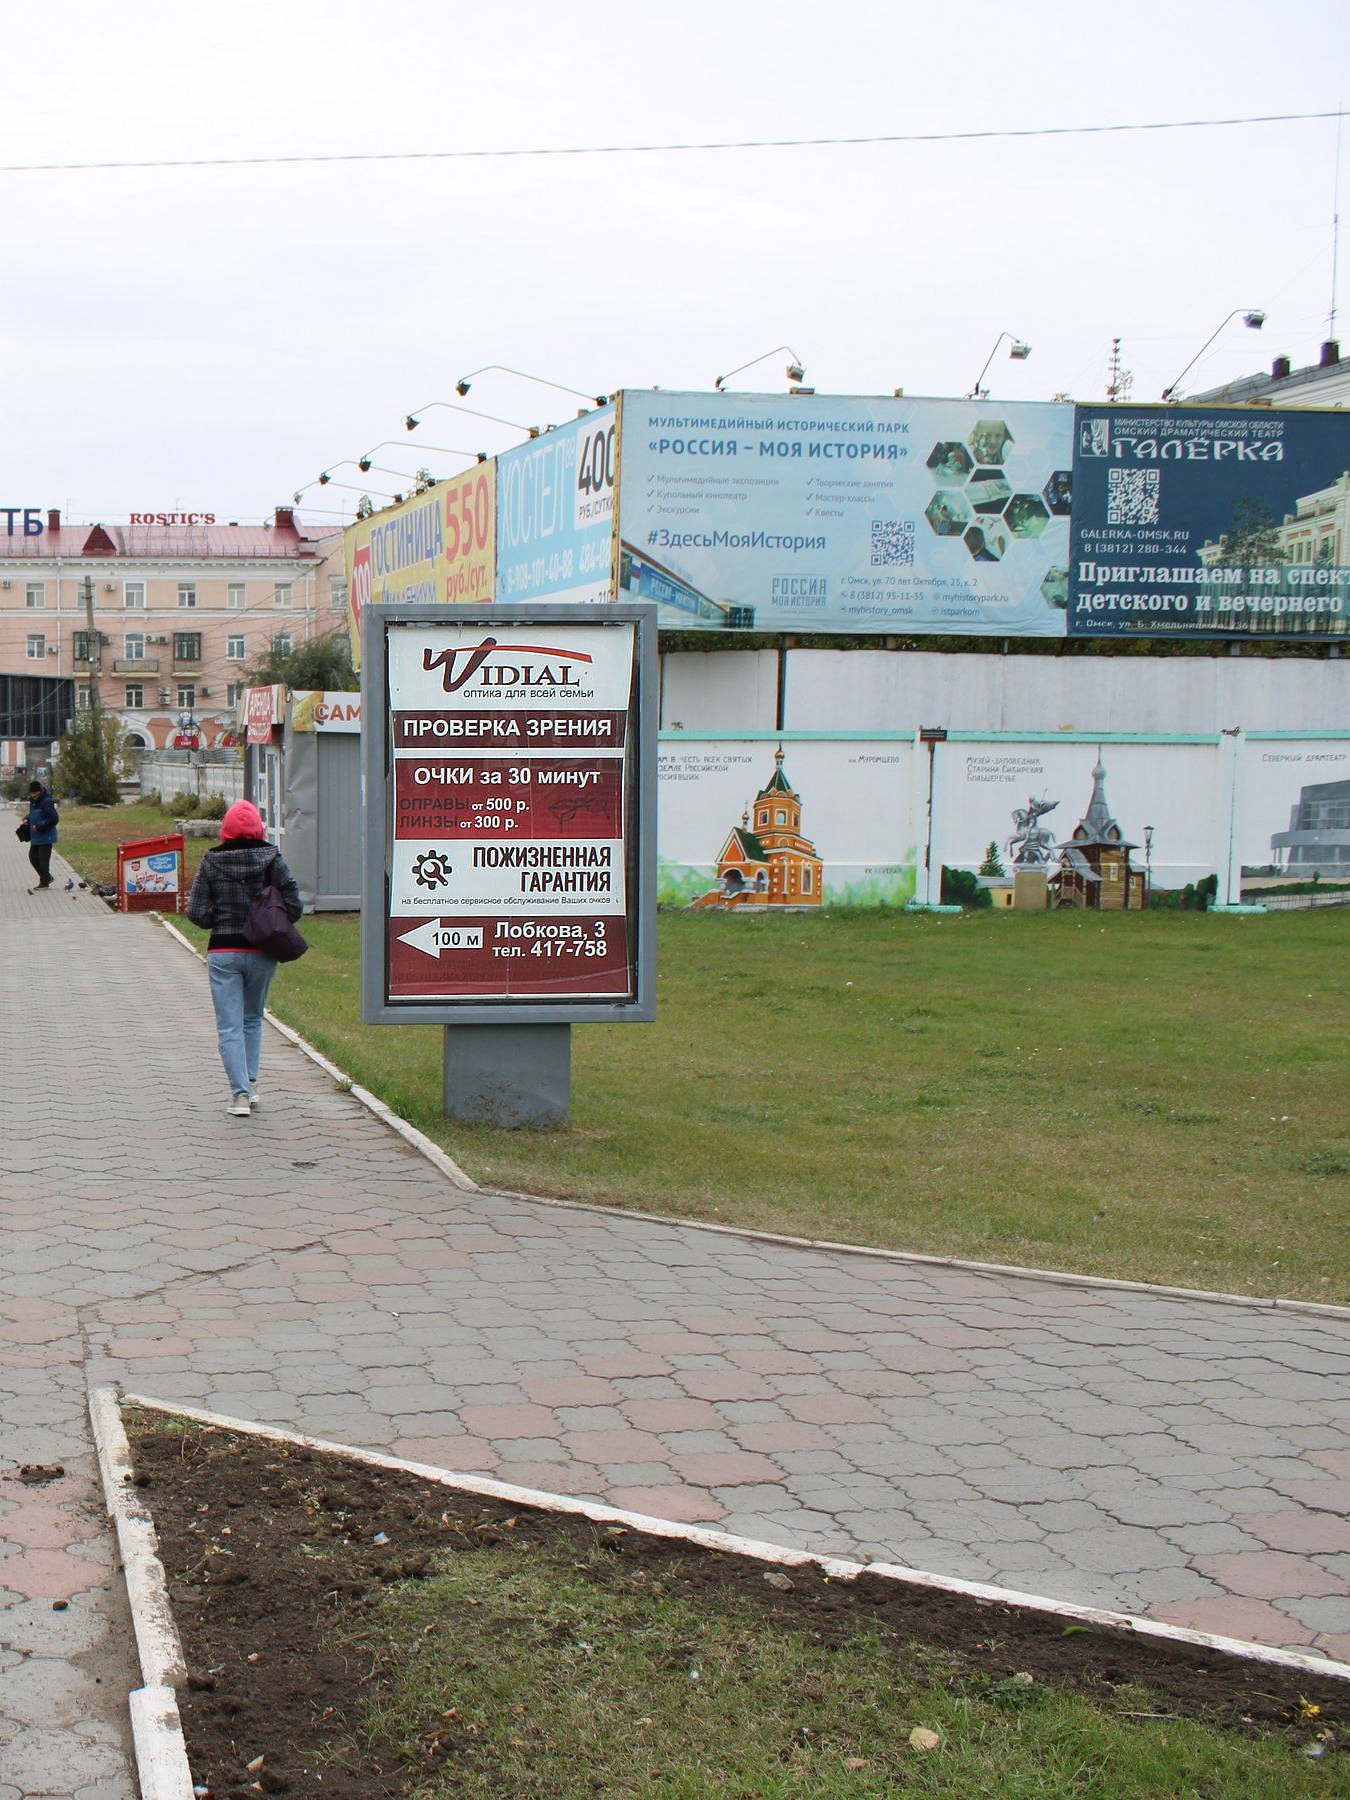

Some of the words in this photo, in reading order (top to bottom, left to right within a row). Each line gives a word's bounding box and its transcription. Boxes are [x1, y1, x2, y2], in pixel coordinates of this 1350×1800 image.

[649, 417, 774, 430] МУЛЬТИМЕДИЙНЫЙ
[777, 420, 874, 433] ИСТОРИЧЕСКИЙ
[877, 423, 909, 433] ПАРК
[1114, 418, 1174, 427] МИНИСТЕРСТВО
[1176, 419, 1214, 428] КУЛЬТУРЫ
[1215, 420, 1247, 429] ОМСКОЙ
[1249, 421, 1285, 430] ОБЛАСТИ
[1114, 427, 1157, 435] ОМСКИЙ
[1160, 427, 1248, 438] ДРАМАТИЧЕСКИЙ
[1251, 430, 1284, 438] ТЕАТР
[648, 438, 738, 456] «РОССИЯ
[759, 441, 802, 457] МОЯ
[808, 443, 908, 460] ИСТОРИЯ»
[501, 442, 565, 550] ХОСТЕЛ
[130, 513, 216, 525] ROSTIC'S
[446, 475, 488, 561] 550
[370, 499, 443, 580] ГОСТИНИЦА
[647, 529, 826, 553] #ЗдесьМояИстория
[1080, 529, 1189, 541] GALERKA-OMSK.RU
[1084, 543, 1091, 553] 8
[1095, 543, 1133, 554] (3812)
[1137, 544, 1187, 554] 280-344
[884, 577, 896, 585] 70
[1078, 562, 1243, 586] Приглашаем
[1249, 568, 1280, 585] на
[772, 578, 827, 595] РОССИЯ
[771, 595, 789, 607] МОЯ
[790, 596, 827, 607] ИСТОРИЯ
[1076, 593, 1188, 613] детского
[1195, 596, 1211, 612] и
[1218, 596, 1343, 616] вечернего
[463, 688, 502, 699] оптика
[505, 688, 526, 700] для
[530, 687, 556, 699] всей
[560, 688, 594, 699] семьи
[403, 719, 521, 737] ПРОВЕРКА
[526, 719, 612, 737] ЗРЕНИЯ
[414, 768, 474, 785] ОЧКИ
[479, 771, 502, 785] за
[507, 768, 531, 785] 30
[537, 771, 601, 788] минут
[657, 773, 700, 781] ОСИЯВШИХ
[401, 798, 469, 811] ОПРАВЫ
[471, 803, 483, 811] от
[486, 798, 512, 811] 500
[516, 801, 530, 813] р.
[400, 816, 458, 828] ЛИНЗЫ
[460, 820, 472, 829] от
[474, 816, 501, 828] 300
[504, 819, 519, 831] р.
[473, 846, 611, 868] ПОЖИЗНЕННАЯ
[520, 871, 611, 892] ГАРАНТИЯ
[413, 897, 459, 905] бесплатное
[461, 898, 502, 906] сервисное
[503, 897, 560, 906] обслуживание
[561, 896, 588, 905] Ваших
[589, 897, 611, 905] очков
[432, 931, 461, 946] 100
[466, 935, 479, 946] м
[493, 921, 588, 940] Лобкова,
[594, 921, 606, 938] 3
[492, 946, 526, 958] тел.
[530, 940, 607, 958] 417-758
